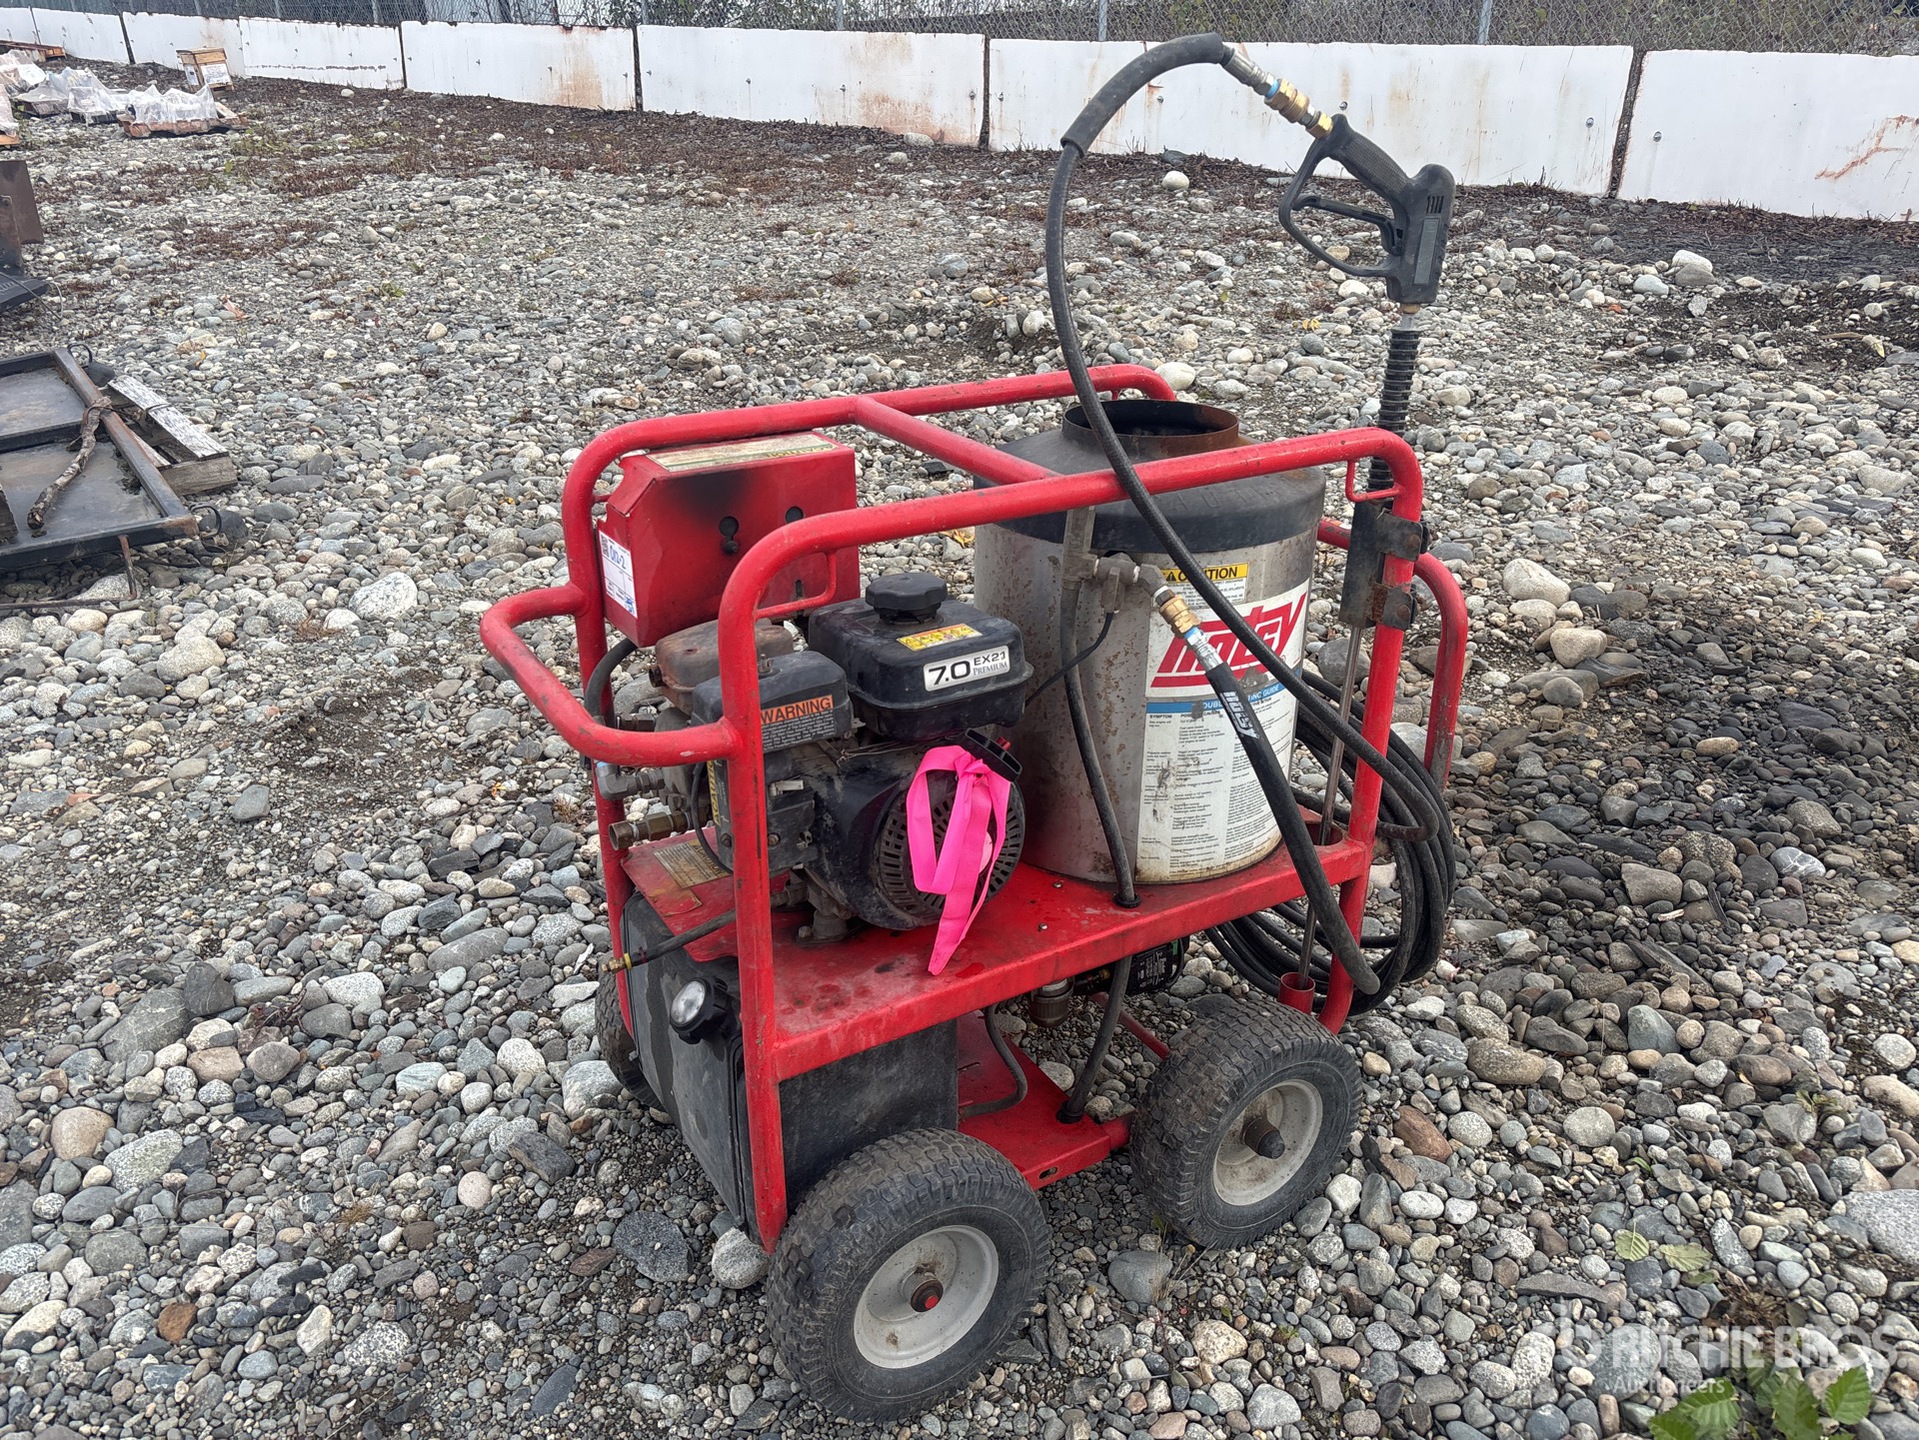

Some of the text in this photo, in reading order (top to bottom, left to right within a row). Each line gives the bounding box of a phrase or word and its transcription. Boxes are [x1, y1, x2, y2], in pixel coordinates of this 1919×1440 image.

[1178, 566, 1238, 581] CTION
[973, 651, 1007, 666] EX21
[928, 660, 971, 686] 7.0
[973, 661, 1008, 676] PREMIUM
[760, 697, 832, 724] WARNING
